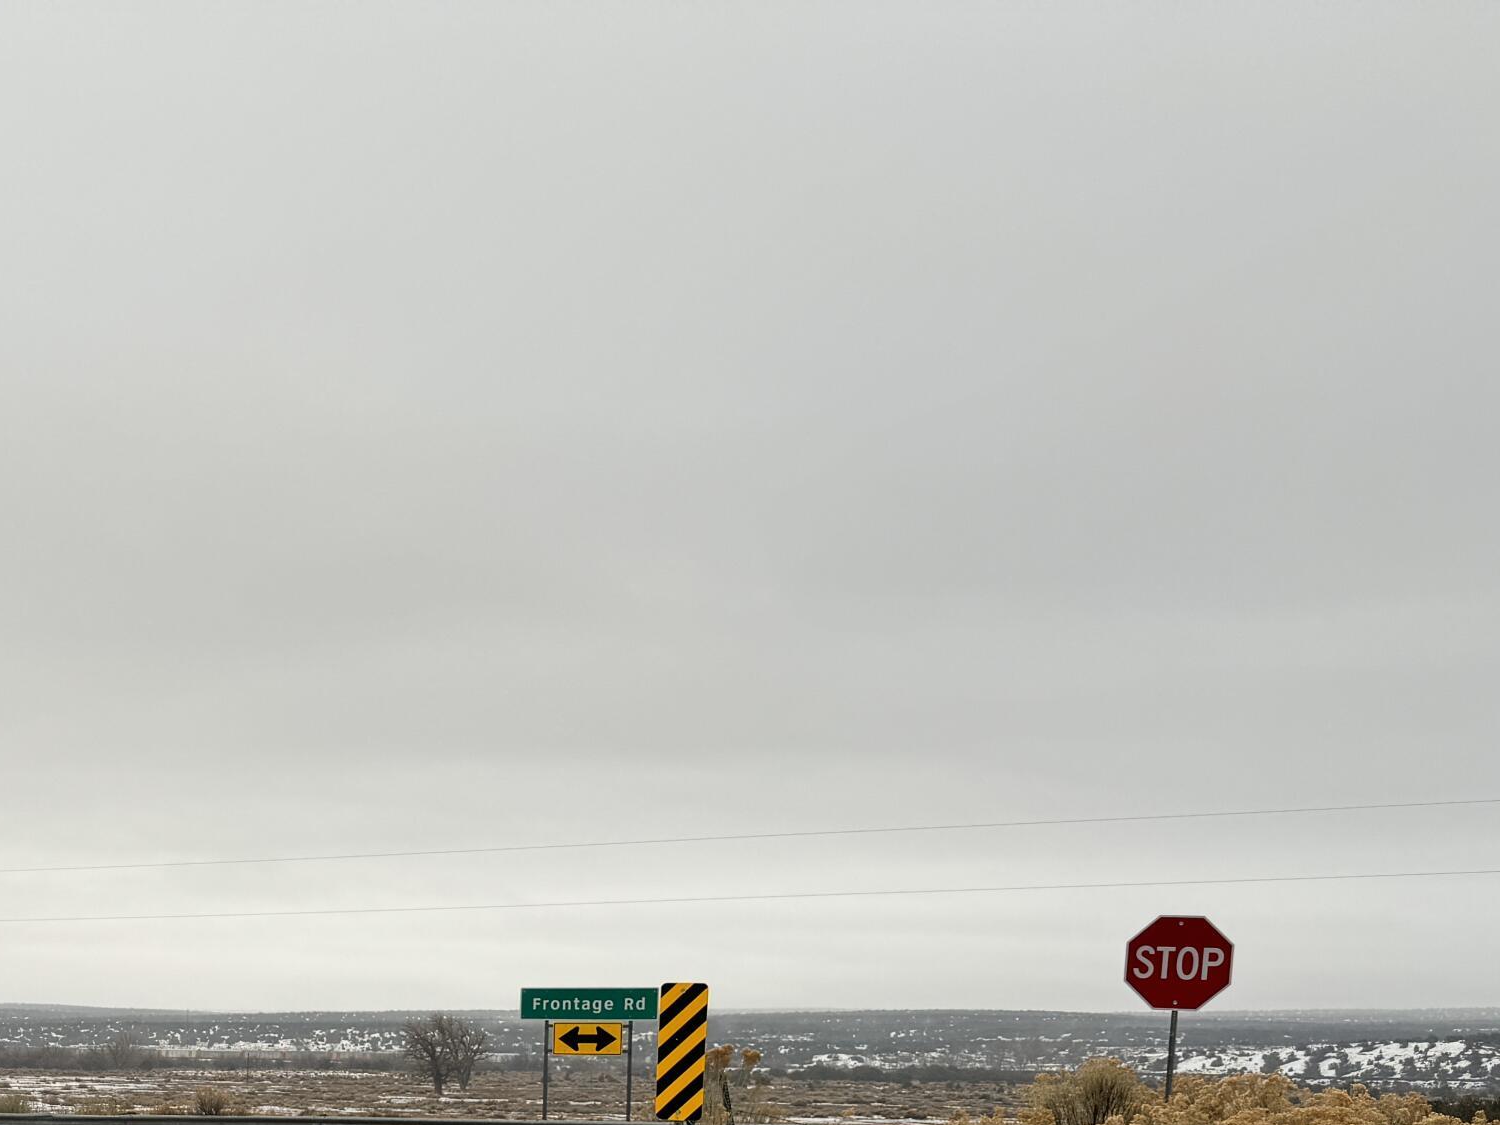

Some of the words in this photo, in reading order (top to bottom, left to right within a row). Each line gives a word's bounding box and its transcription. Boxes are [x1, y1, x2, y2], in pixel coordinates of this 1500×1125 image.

[1133, 945, 1225, 981] STOP
[532, 997, 614, 1014] Frontage
[624, 997, 646, 1010] Rd
